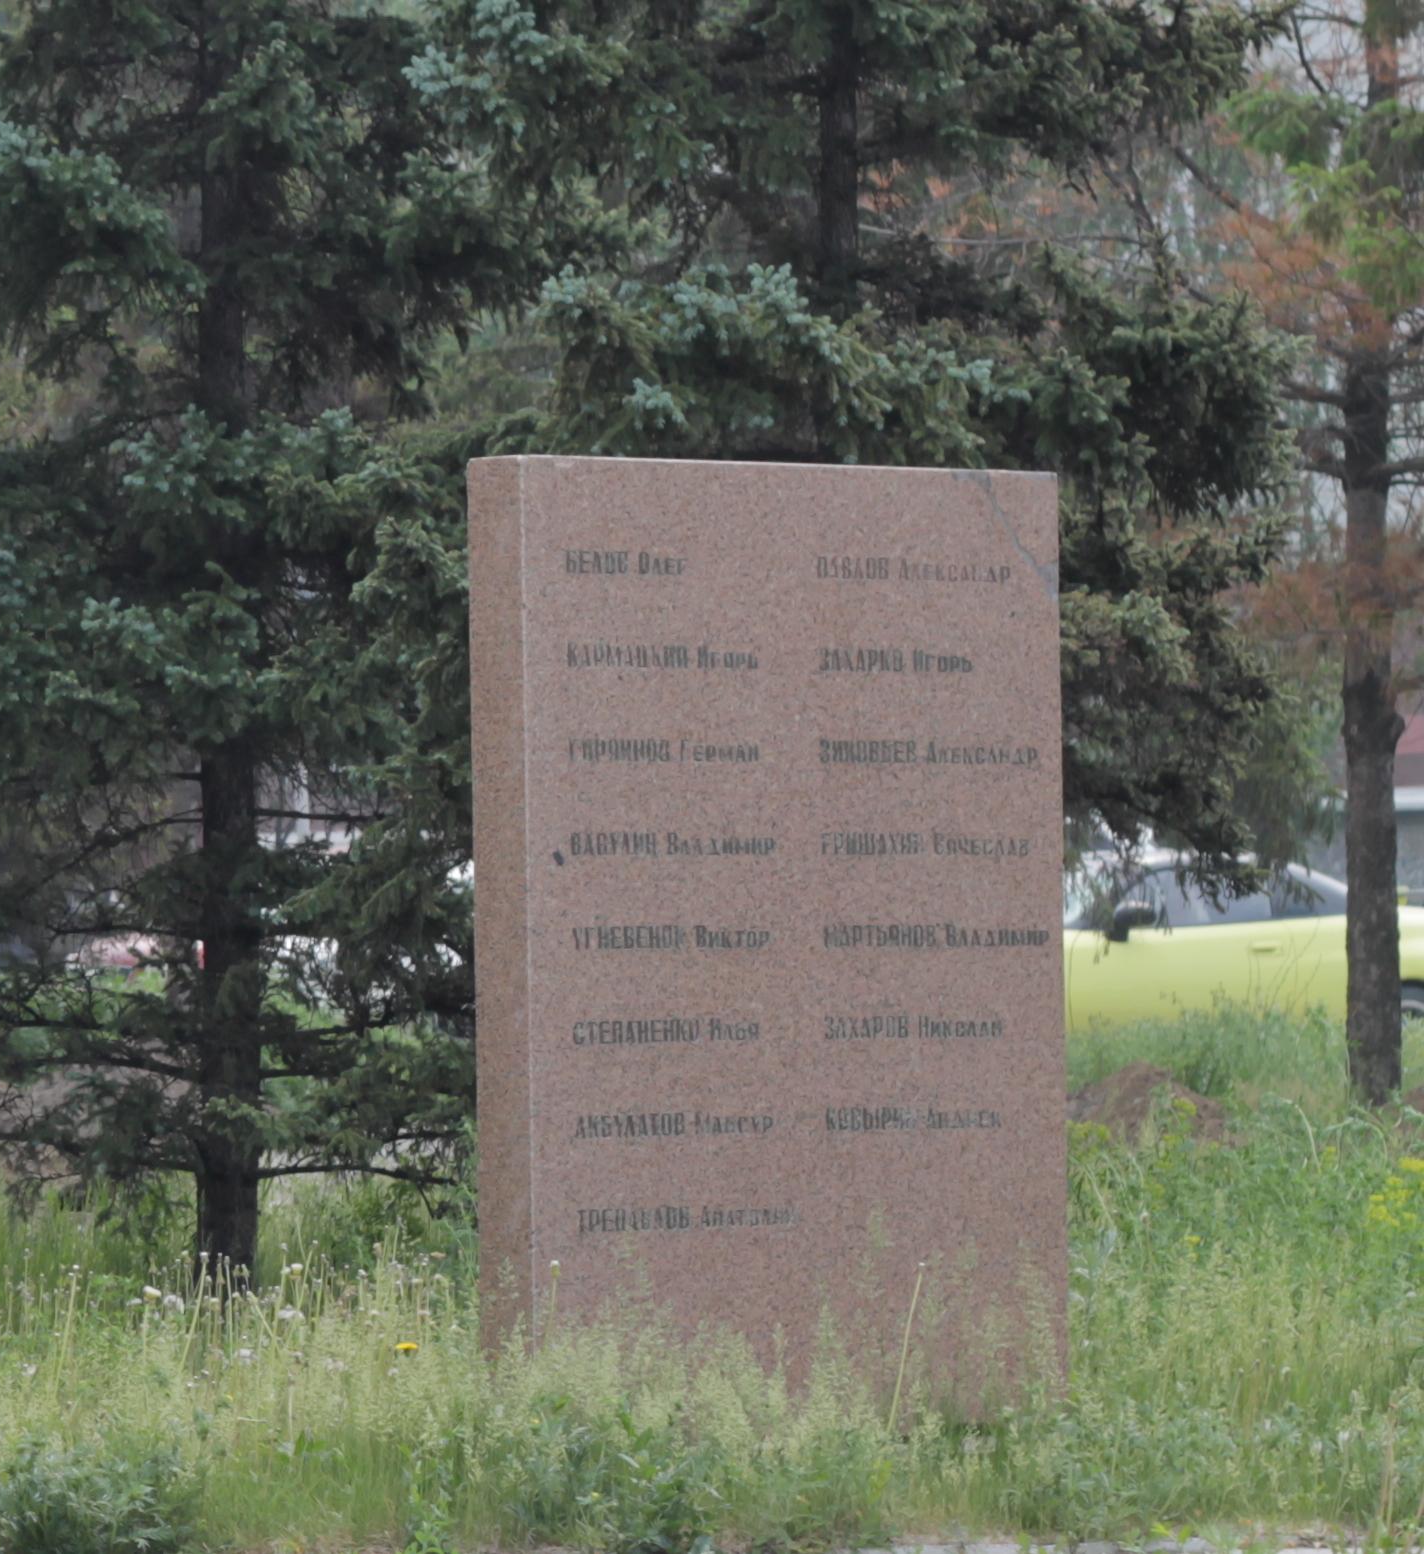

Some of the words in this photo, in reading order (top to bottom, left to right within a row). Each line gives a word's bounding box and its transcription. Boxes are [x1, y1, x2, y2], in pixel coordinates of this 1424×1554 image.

[637, 551, 688, 576] Олег
[815, 555, 889, 581] ПАВЛОВ
[898, 557, 1012, 585] Александр
[696, 645, 759, 671] Игорь
[912, 648, 974, 674] Игорь
[679, 738, 760, 763] Герман
[819, 738, 917, 765] ЗИНОВЬЕВ
[926, 740, 1040, 768] Александр
[666, 831, 776, 857] Владимир
[933, 830, 1030, 858] Вячеслав
[694, 923, 771, 950] Виктор
[823, 923, 937, 949] МАРТЬЯНОВ
[944, 921, 1050, 949] Владимир
[572, 1018, 700, 1046] СТЕПАНЕНКО
[708, 1017, 761, 1043] Илья
[824, 1014, 909, 1041] ЗАХАРОВ
[917, 1014, 1004, 1041] Николай
